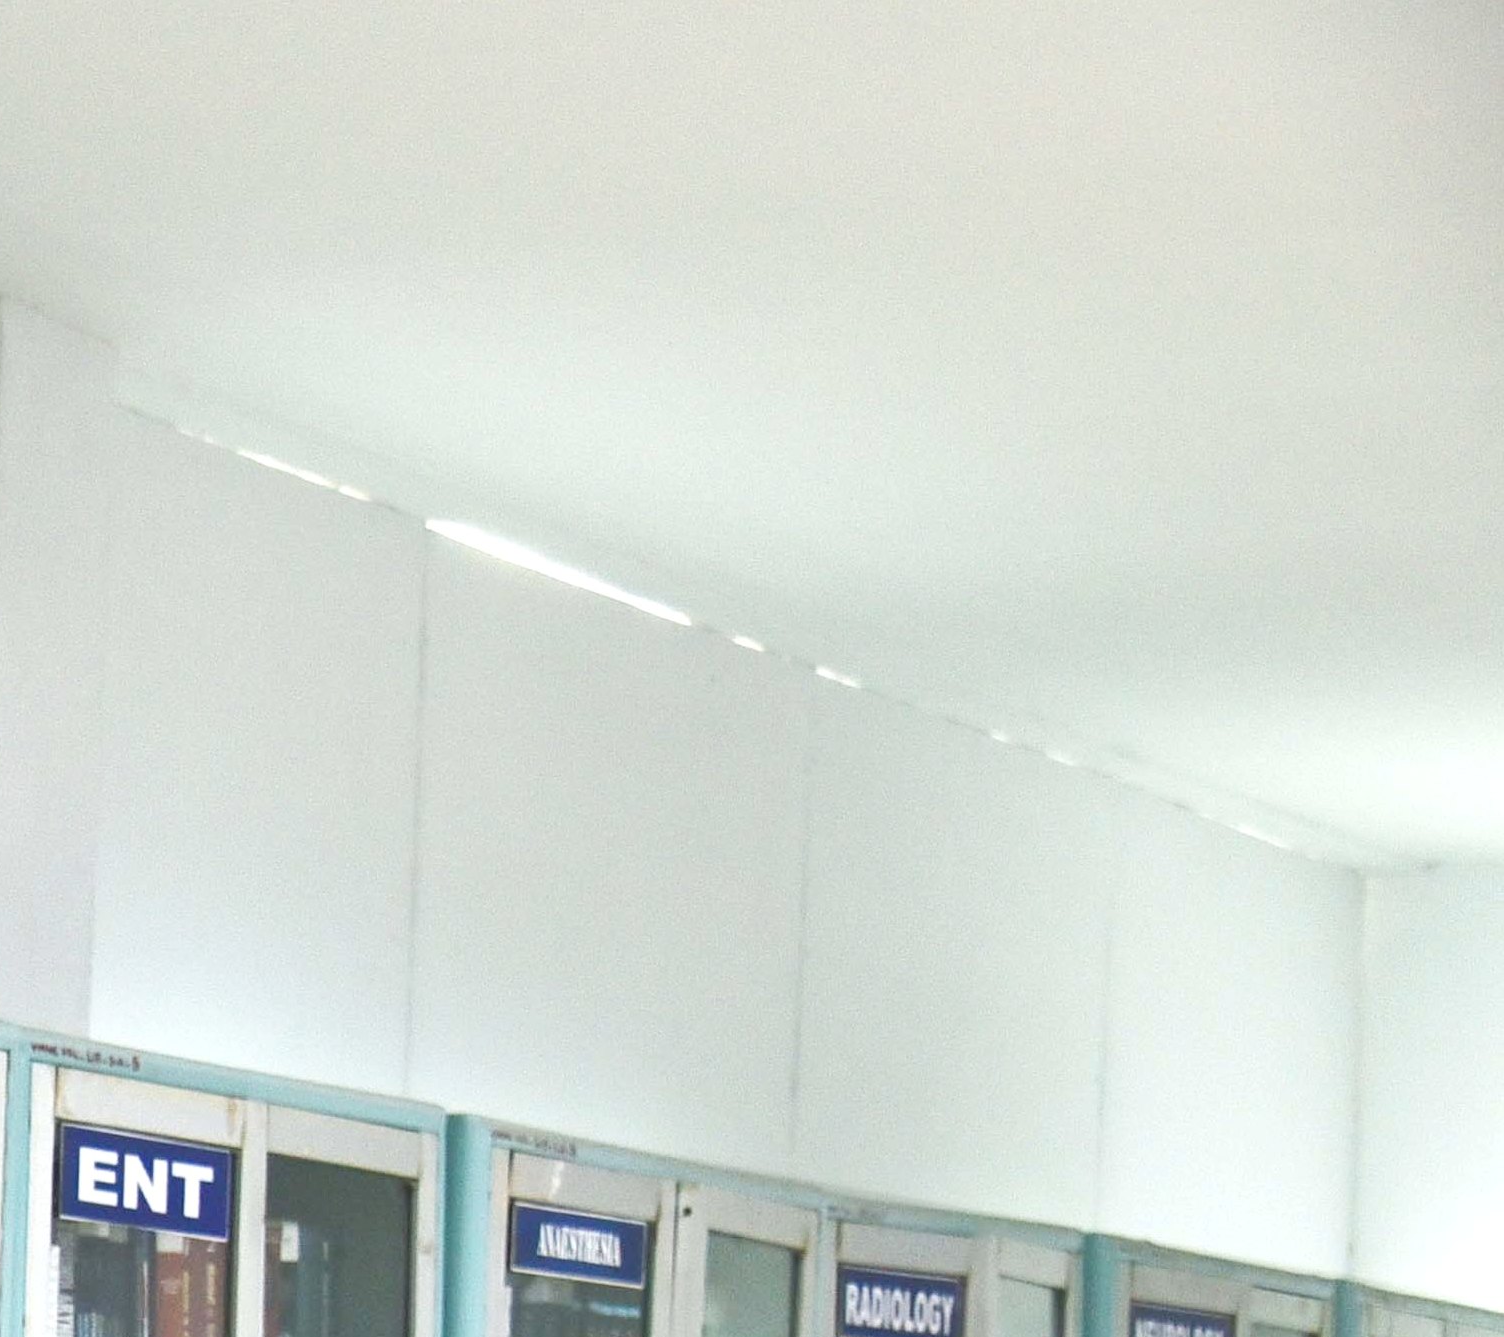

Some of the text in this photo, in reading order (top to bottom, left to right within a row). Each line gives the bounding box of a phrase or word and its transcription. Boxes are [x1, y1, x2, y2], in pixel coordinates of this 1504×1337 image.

[77, 1146, 214, 1219] ENT
[537, 1222, 621, 1268] ANAESTHESIA
[845, 1283, 954, 1337] RADIOLOGY
